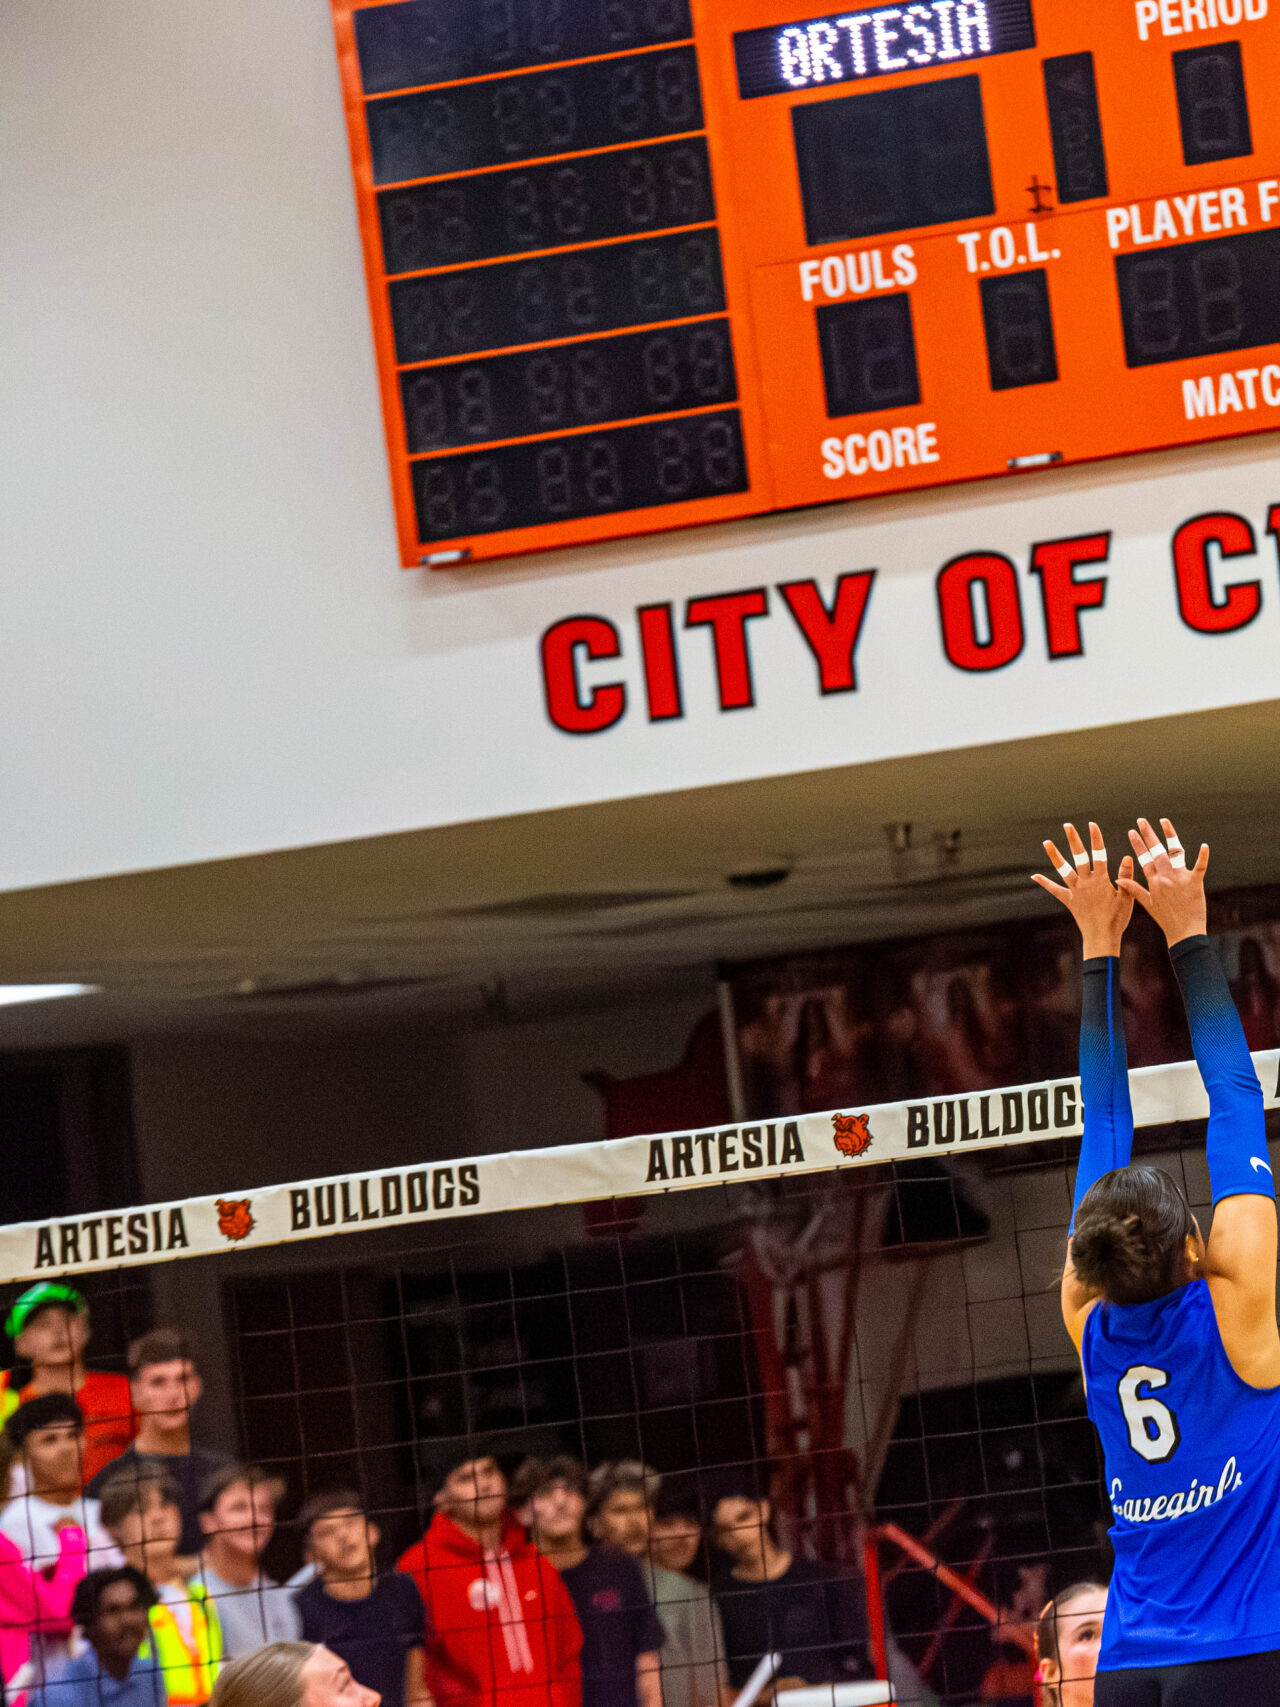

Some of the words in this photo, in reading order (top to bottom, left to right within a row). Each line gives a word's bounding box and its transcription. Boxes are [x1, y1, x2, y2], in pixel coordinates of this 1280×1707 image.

[1135, 0, 1268, 41] PERIOD
[957, 222, 1062, 273] T.O.L.
[1106, 191, 1248, 249] PLAYER
[799, 243, 918, 301] FOULS
[821, 422, 940, 479] SCORE
[540, 569, 877, 736] CITY
[935, 531, 1112, 673] OF
[645, 1121, 805, 1182] ARTESIA
[906, 1083, 1083, 1149] BULLDOG
[35, 1208, 189, 1269] ARTESIA
[290, 1164, 480, 1231] BULLDOGS
[1117, 1364, 1182, 1465] 6
